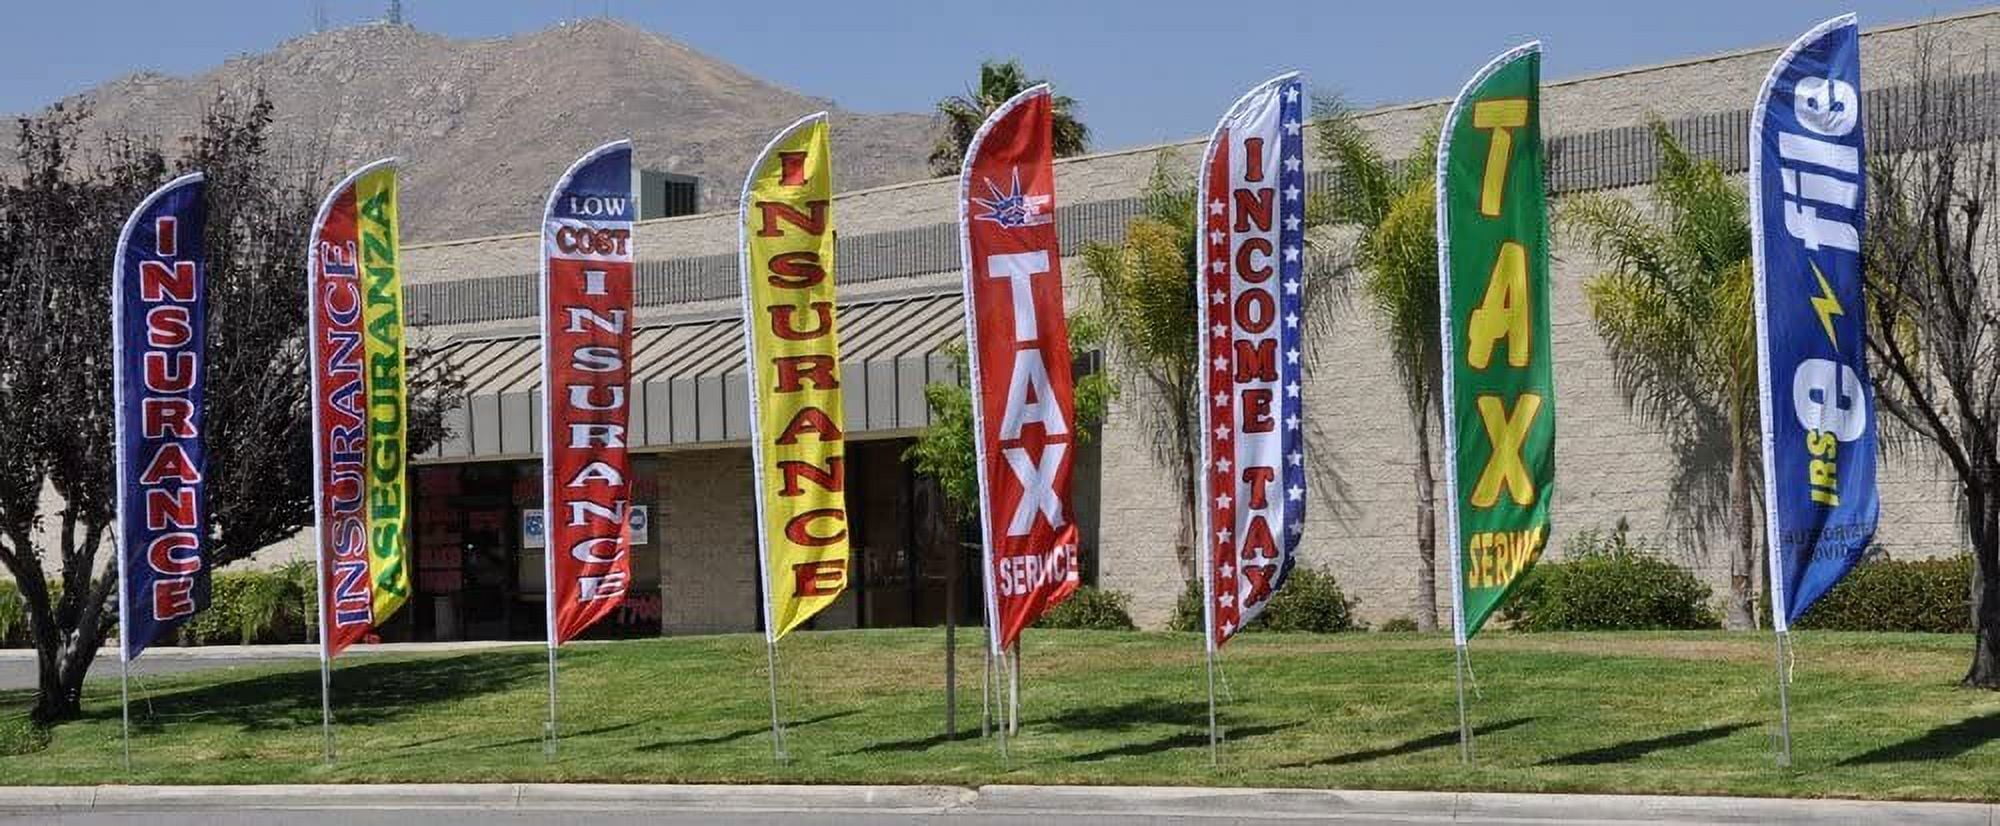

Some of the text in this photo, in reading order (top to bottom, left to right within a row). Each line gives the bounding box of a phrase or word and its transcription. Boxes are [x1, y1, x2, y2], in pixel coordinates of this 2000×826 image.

[556, 225, 631, 256] COST
[569, 196, 626, 217] LOW
[1467, 95, 1541, 508] TAX
[1777, 75, 1860, 253] file
[139, 216, 202, 623] INSURANCE
[321, 240, 372, 629] INSURANCE
[361, 188, 408, 598] ASEGURANZA
[563, 269, 628, 603] INSURANCE
[754, 150, 848, 599] INSURANCE
[988, 250, 1068, 538] TAX
[1232, 137, 1279, 609] INCOME TAX
[1805, 428, 1842, 508] IRS
[999, 543, 1081, 597] SERVICE
[1468, 526, 1543, 590] SERVIC
